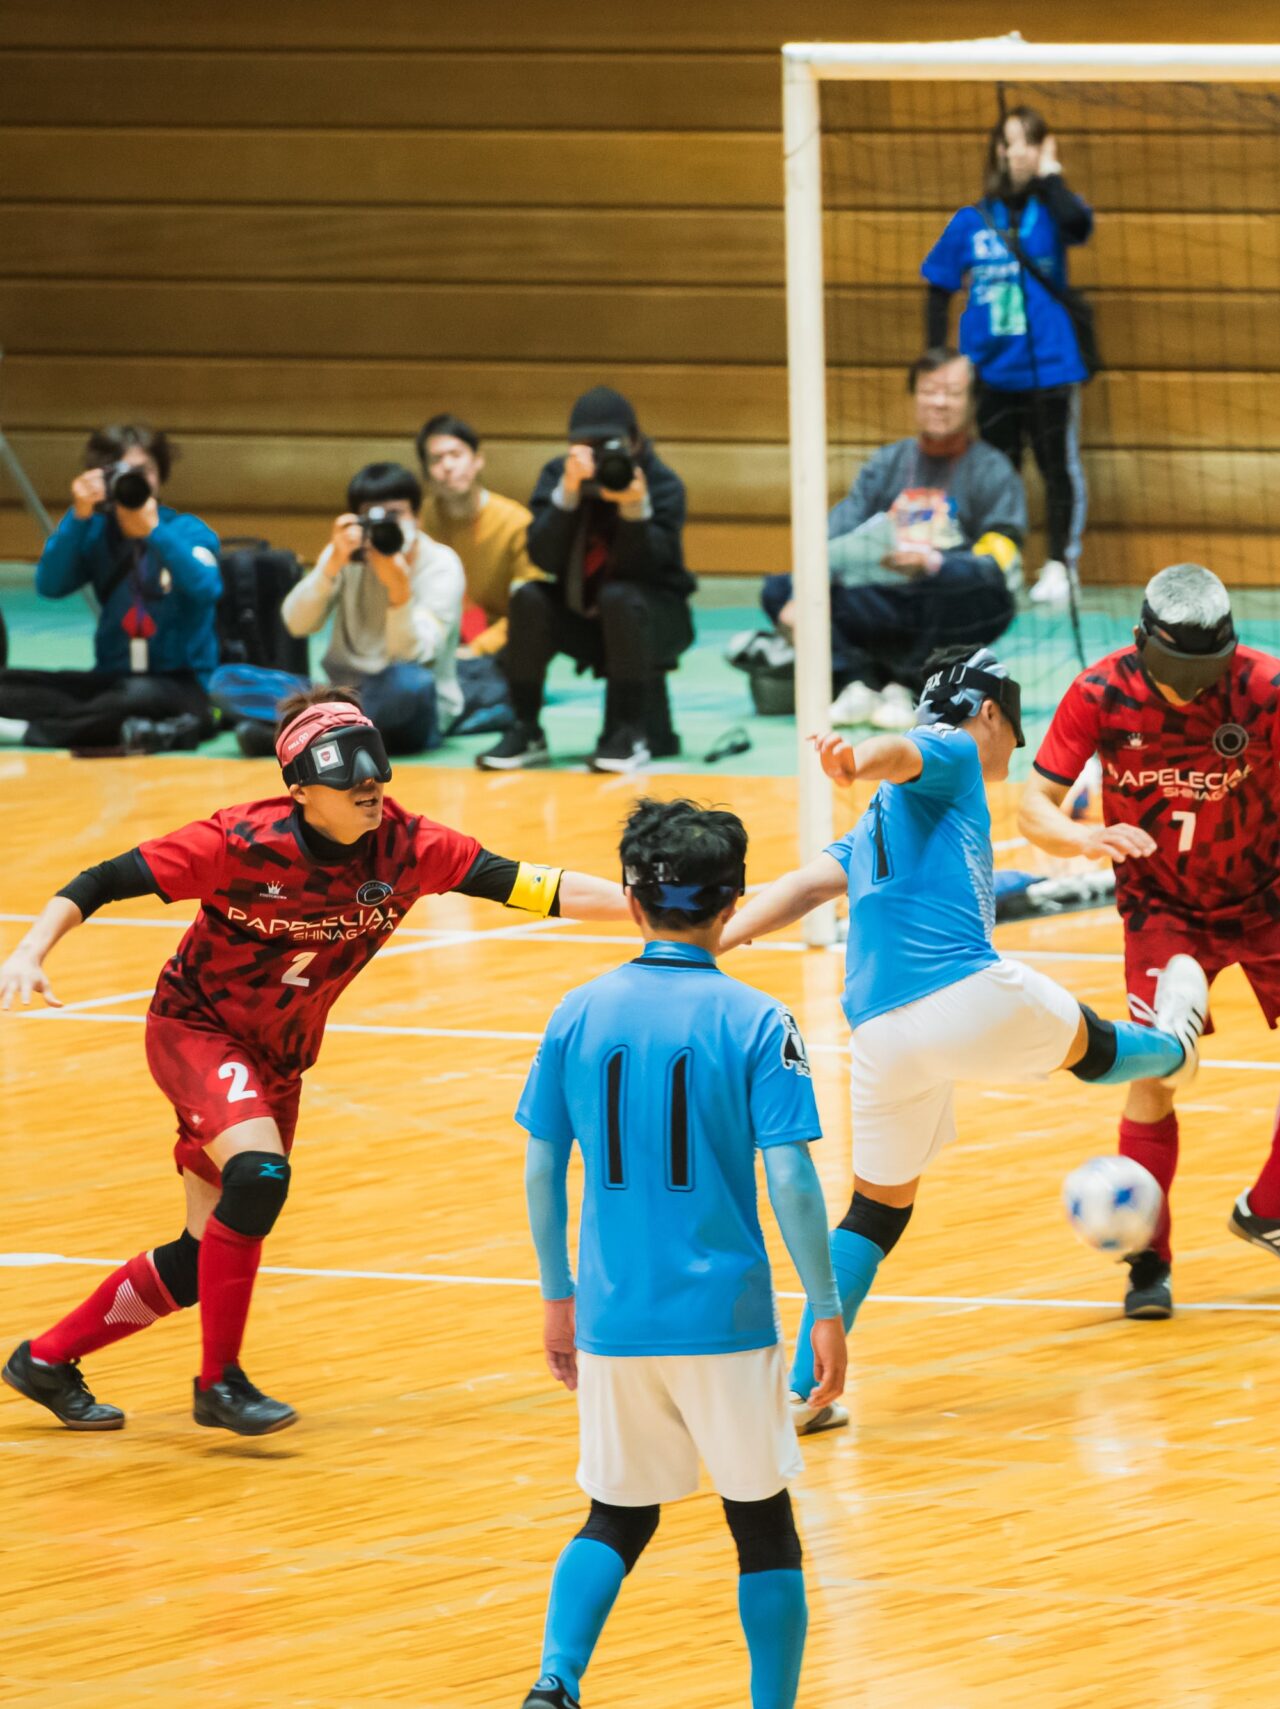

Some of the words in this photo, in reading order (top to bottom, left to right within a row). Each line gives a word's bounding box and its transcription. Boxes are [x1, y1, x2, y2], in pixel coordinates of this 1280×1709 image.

[1171, 810, 1196, 852] 7
[281, 951, 318, 988] 2
[218, 1061, 258, 1103] 2
[604, 1047, 692, 1190] 11
